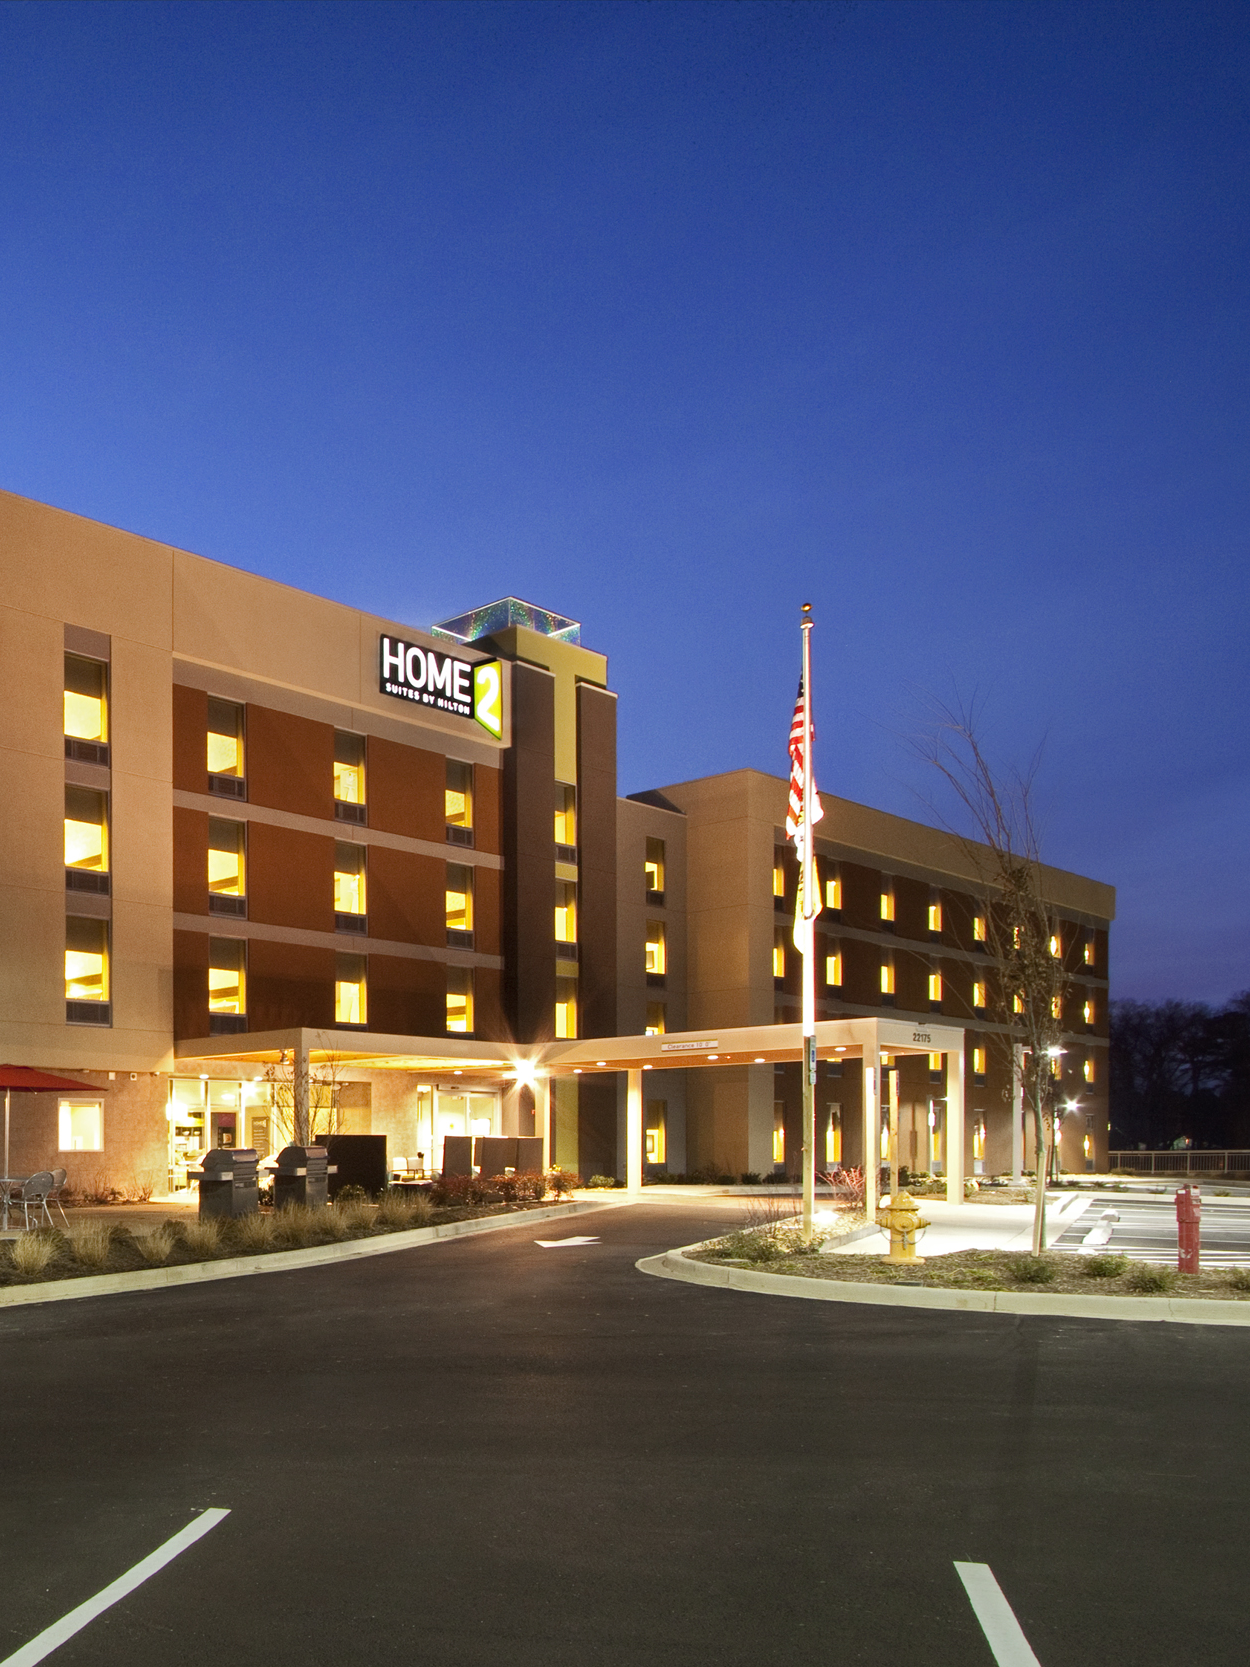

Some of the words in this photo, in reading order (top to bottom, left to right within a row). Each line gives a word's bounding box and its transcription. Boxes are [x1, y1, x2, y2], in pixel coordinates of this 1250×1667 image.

[383, 637, 472, 703] HOME
[477, 666, 500, 732] 2
[385, 682, 420, 700] SUITES
[422, 693, 435, 705] BY
[437, 697, 470, 715] HILTON
[912, 1032, 931, 1043] 22175
